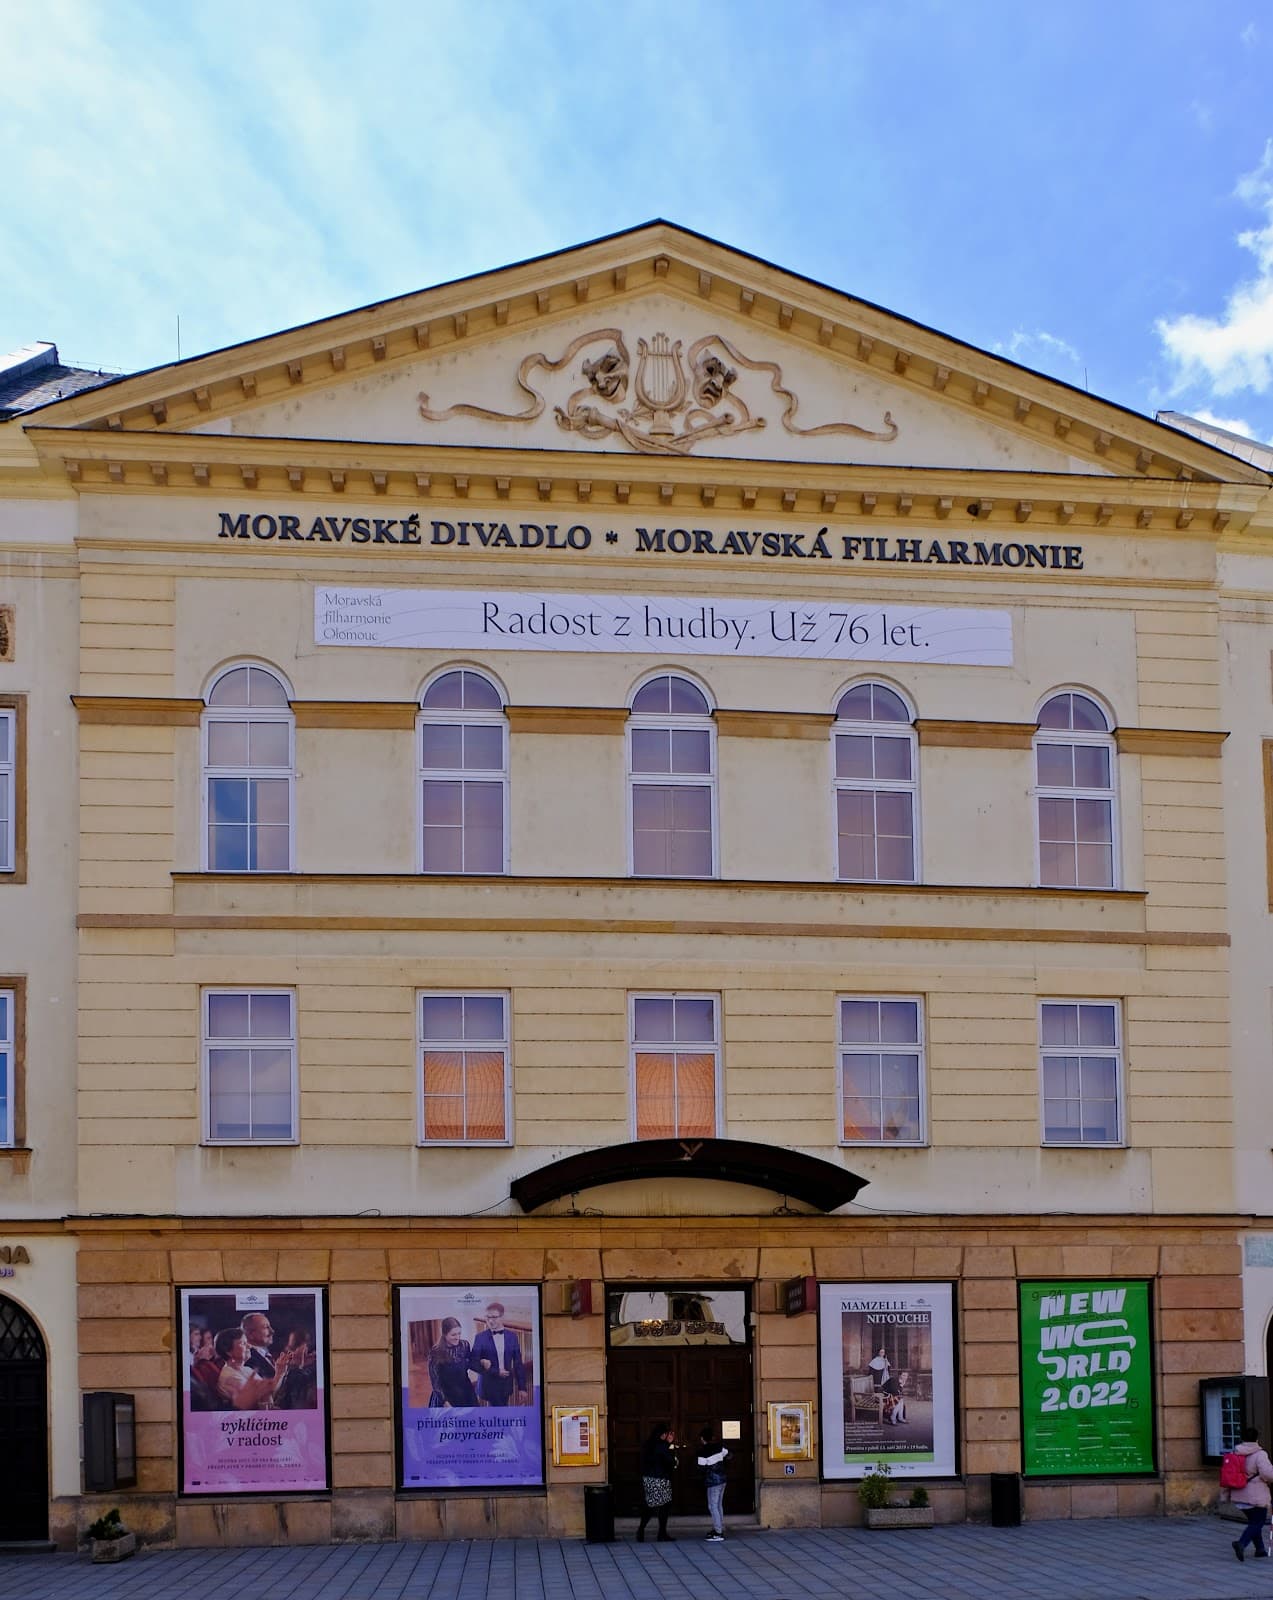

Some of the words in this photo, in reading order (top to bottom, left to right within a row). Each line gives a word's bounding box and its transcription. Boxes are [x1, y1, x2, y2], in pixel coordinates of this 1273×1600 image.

[218, 513, 422, 545] MORAVSKÉ
[430, 520, 592, 550] DIVADLO
[635, 527, 832, 560] MORAVSKÁ
[841, 535, 1084, 570] FILHARMONIE
[325, 593, 383, 607] Moravská
[322, 610, 392, 625] filharmonie
[482, 601, 602, 638] Radost
[614, 616, 632, 637] z
[644, 605, 756, 652] hudby.
[770, 610, 818, 643] Už
[829, 612, 869, 645] 76
[882, 613, 931, 648] let.
[323, 627, 378, 641] Olomouc
[841, 1301, 908, 1311] MAMZELLE
[1040, 1288, 1127, 1320] NEW
[867, 1313, 930, 1324] NITOUCHE
[1041, 1380, 1128, 1412] 2.022
[479, 1416, 527, 1428] kulturní
[238, 1433, 282, 1446] radost
